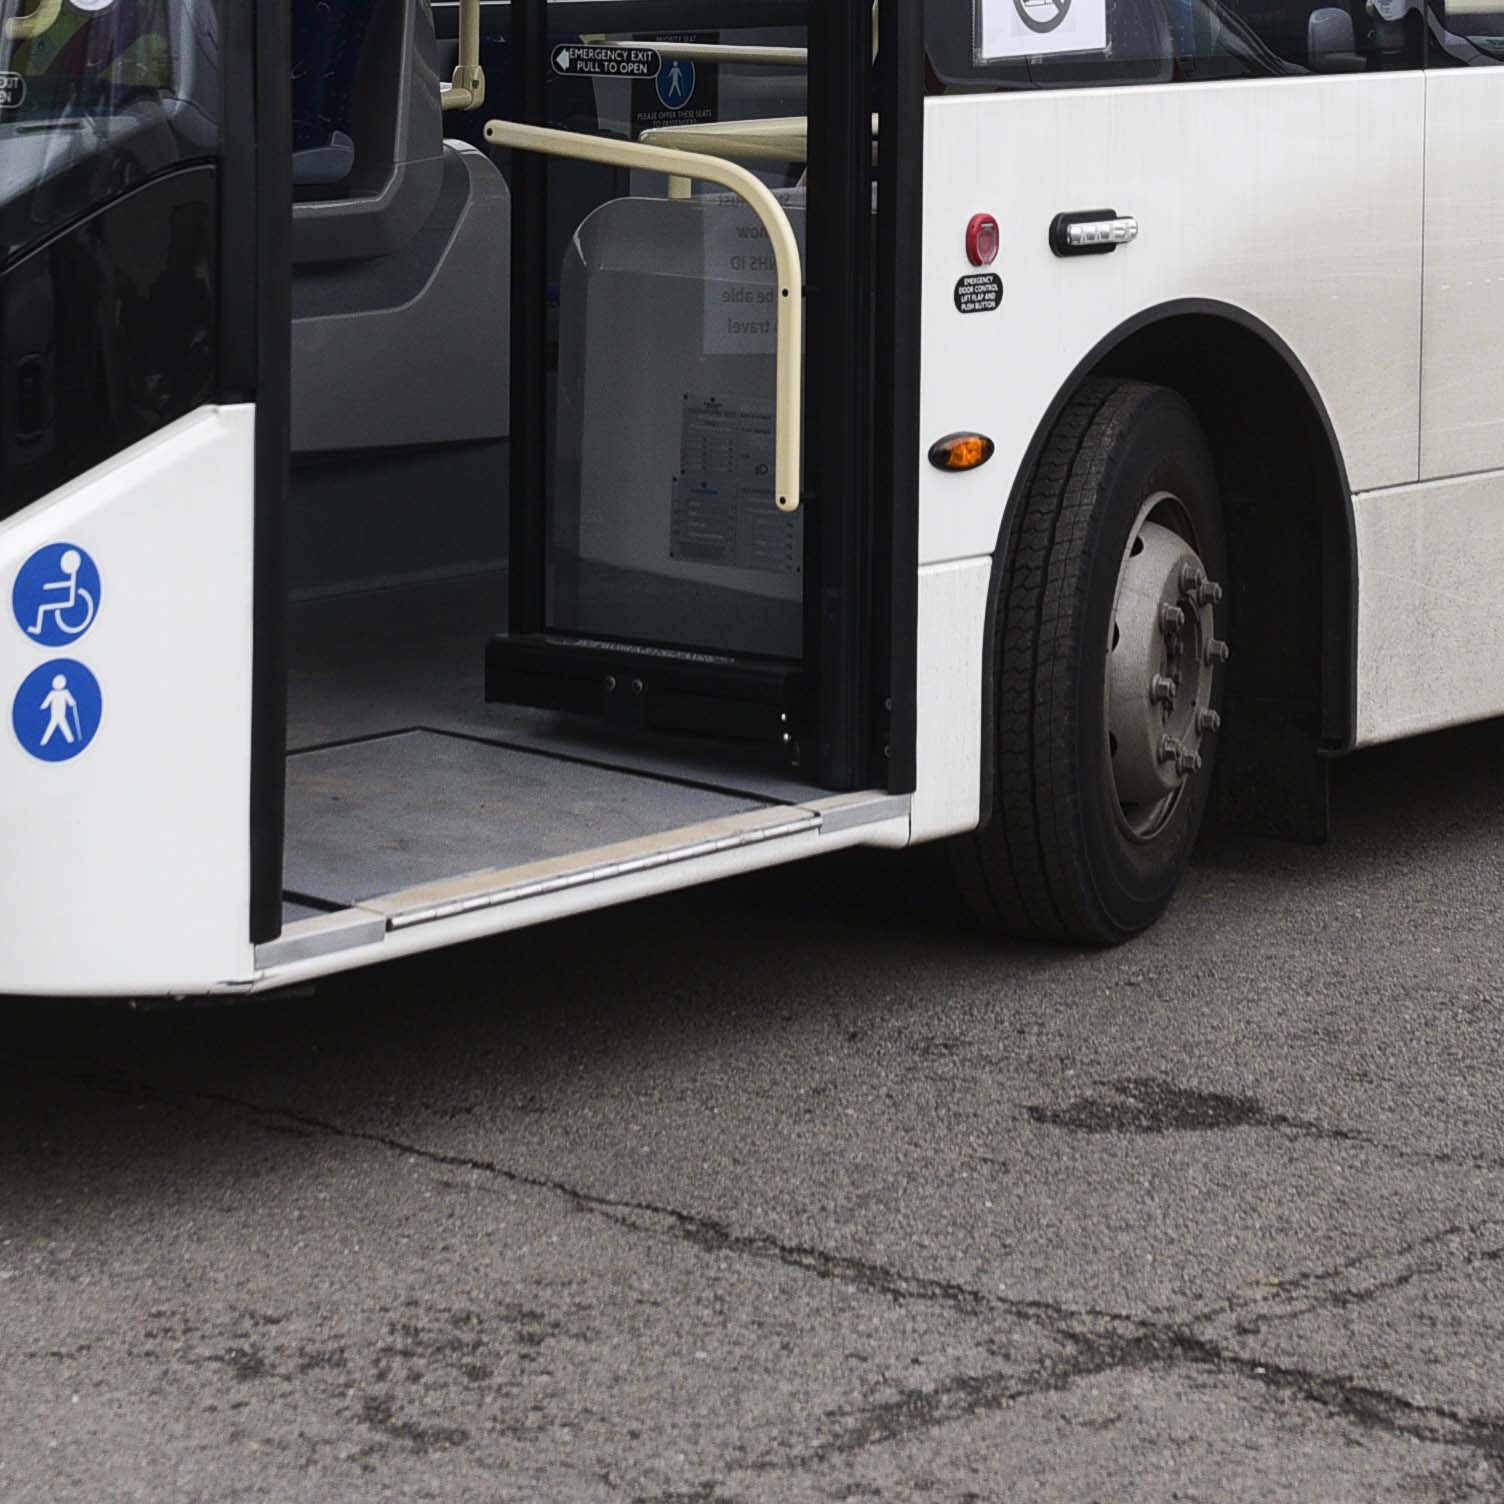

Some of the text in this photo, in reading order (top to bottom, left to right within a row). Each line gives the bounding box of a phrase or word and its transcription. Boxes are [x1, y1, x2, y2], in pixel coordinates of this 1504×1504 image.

[569, 48, 653, 61] EMERGENCY EXIT
[577, 60, 648, 74] PULL TO OPEN
